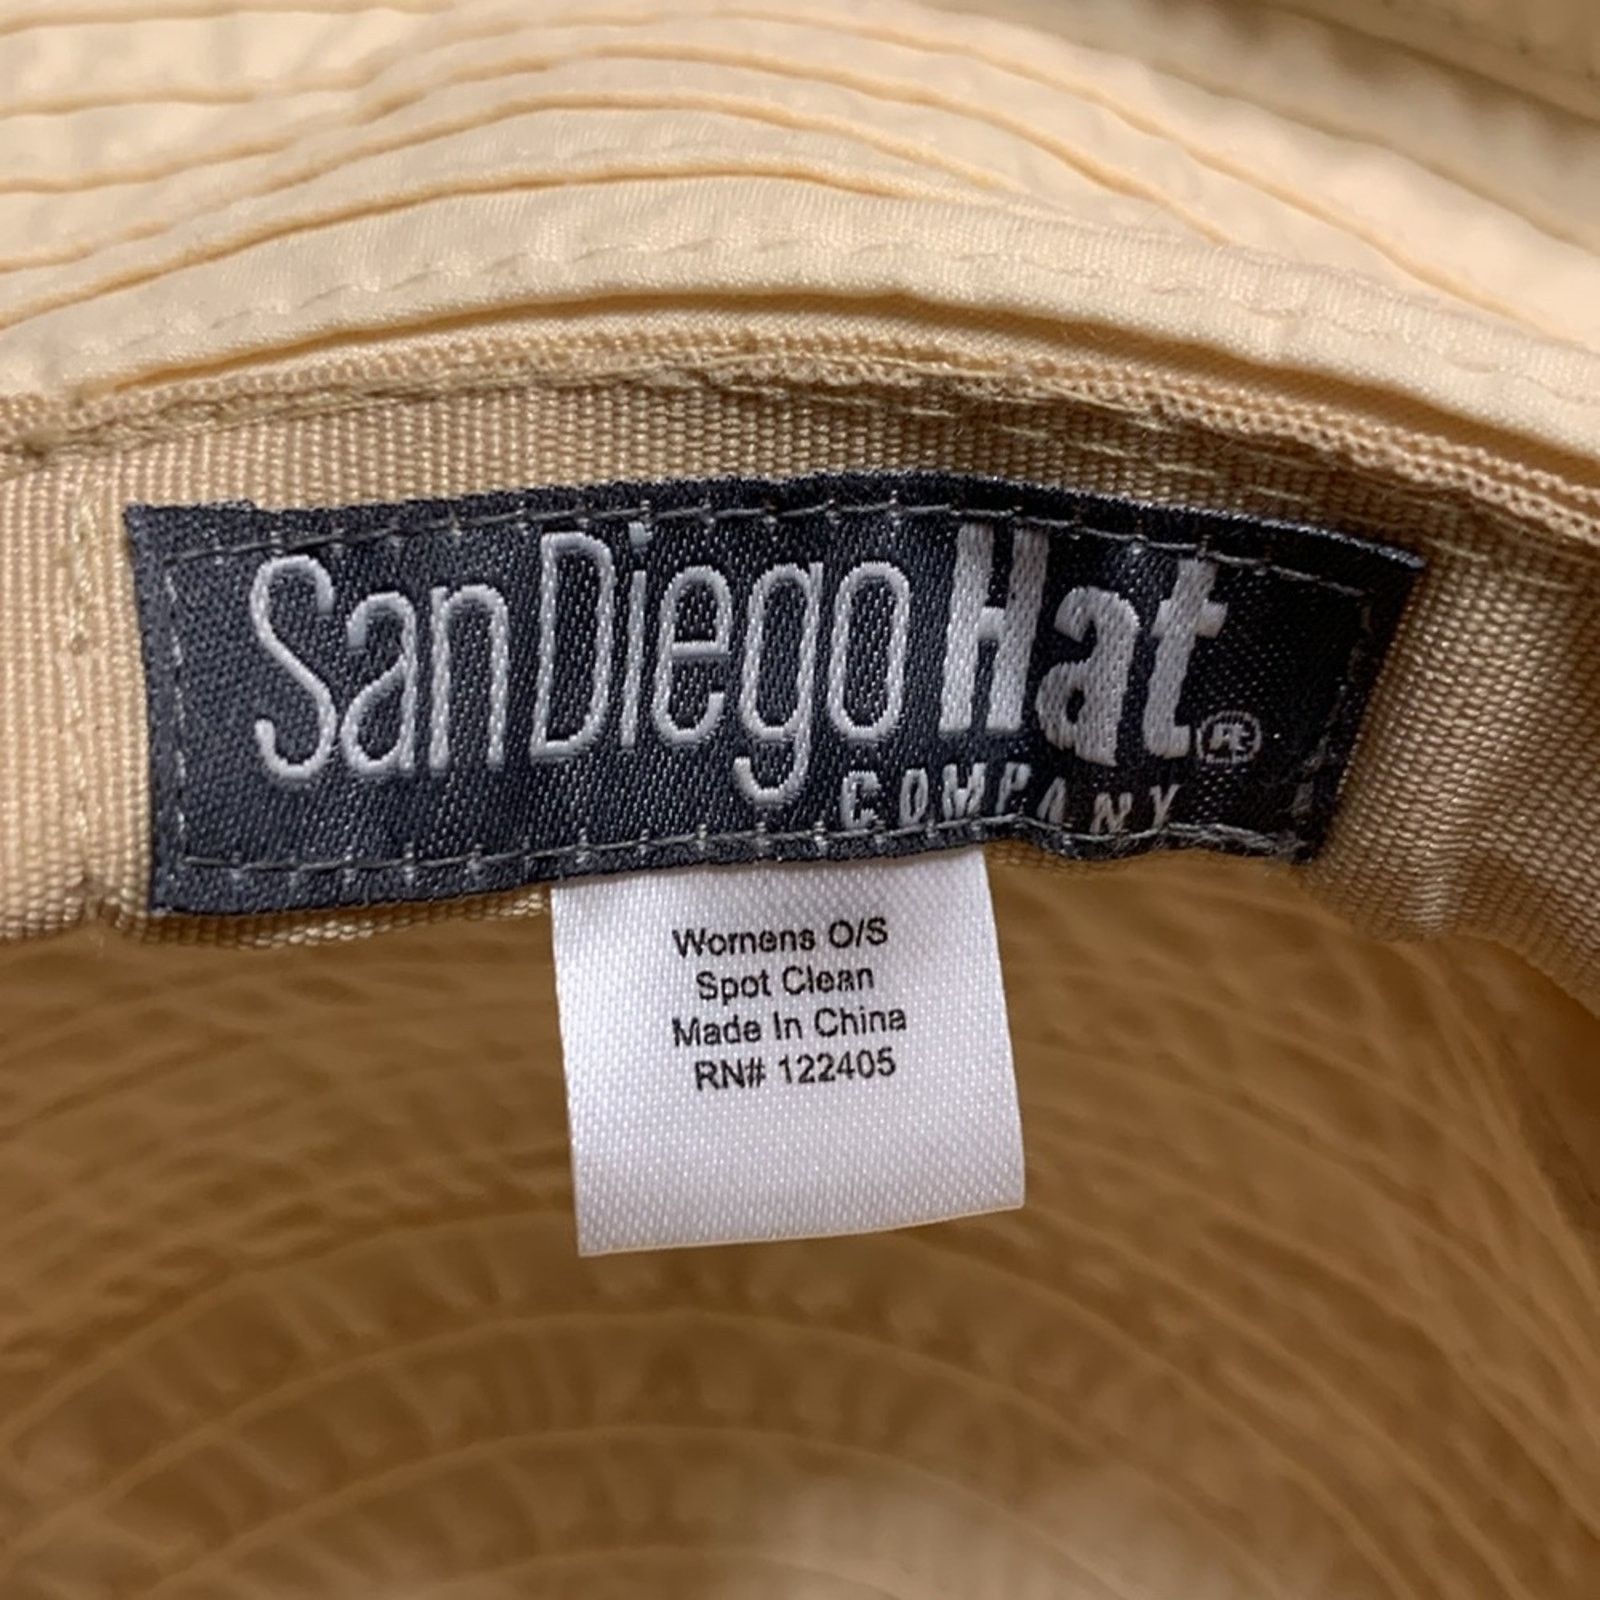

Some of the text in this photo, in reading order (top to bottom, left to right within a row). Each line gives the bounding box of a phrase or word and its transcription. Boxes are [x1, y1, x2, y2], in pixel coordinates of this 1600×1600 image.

[249, 553, 510, 780] San
[529, 520, 912, 804] Diego
[840, 761, 1181, 835] COMPANY
[672, 917, 888, 958] Womens O/S
[696, 965, 874, 1005] Spot Clean
[671, 1006, 907, 1047] Made In China
[694, 1046, 896, 1091] RN# 122405
